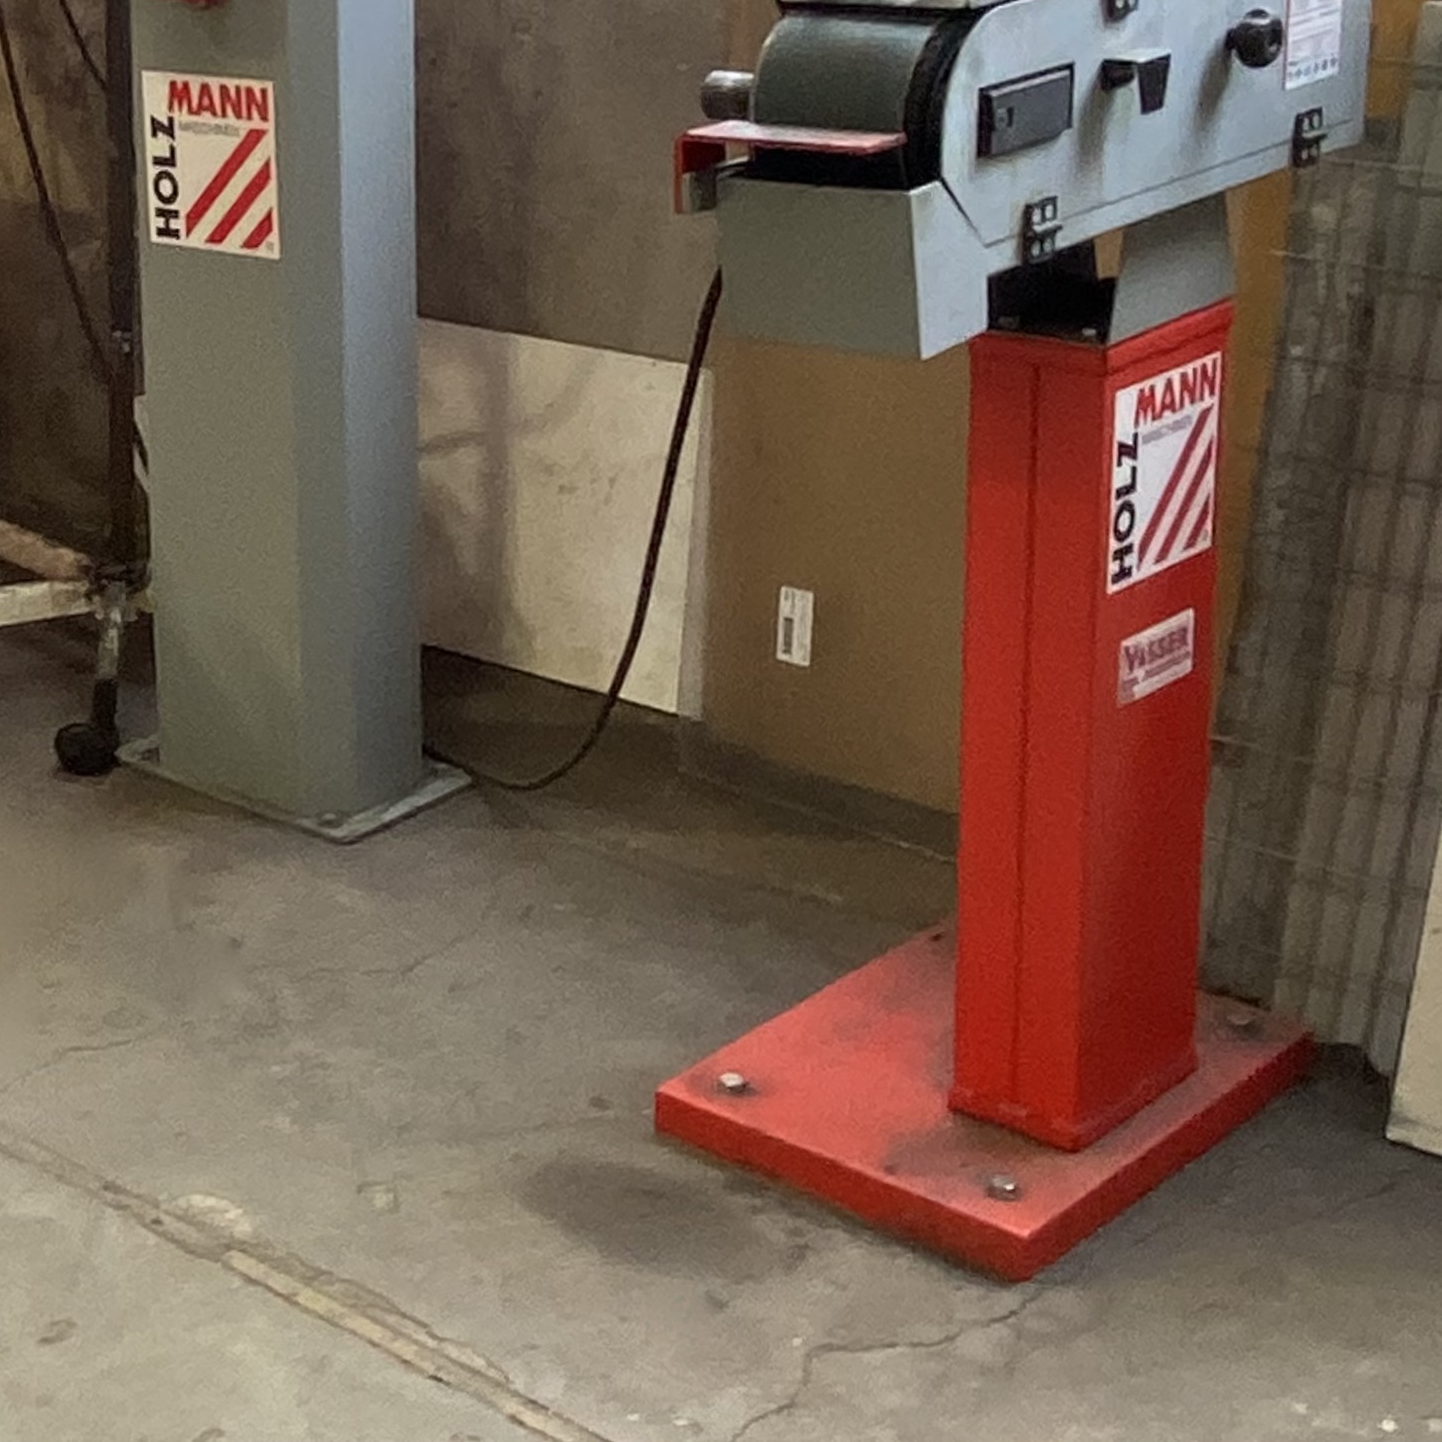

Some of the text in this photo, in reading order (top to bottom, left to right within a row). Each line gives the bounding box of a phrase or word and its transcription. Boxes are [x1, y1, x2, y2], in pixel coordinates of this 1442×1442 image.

[168, 79, 269, 122] MANN
[150, 115, 180, 240] HOLZ
[1134, 358, 1218, 428] MANN
[1111, 431, 1138, 585] HOLZ
